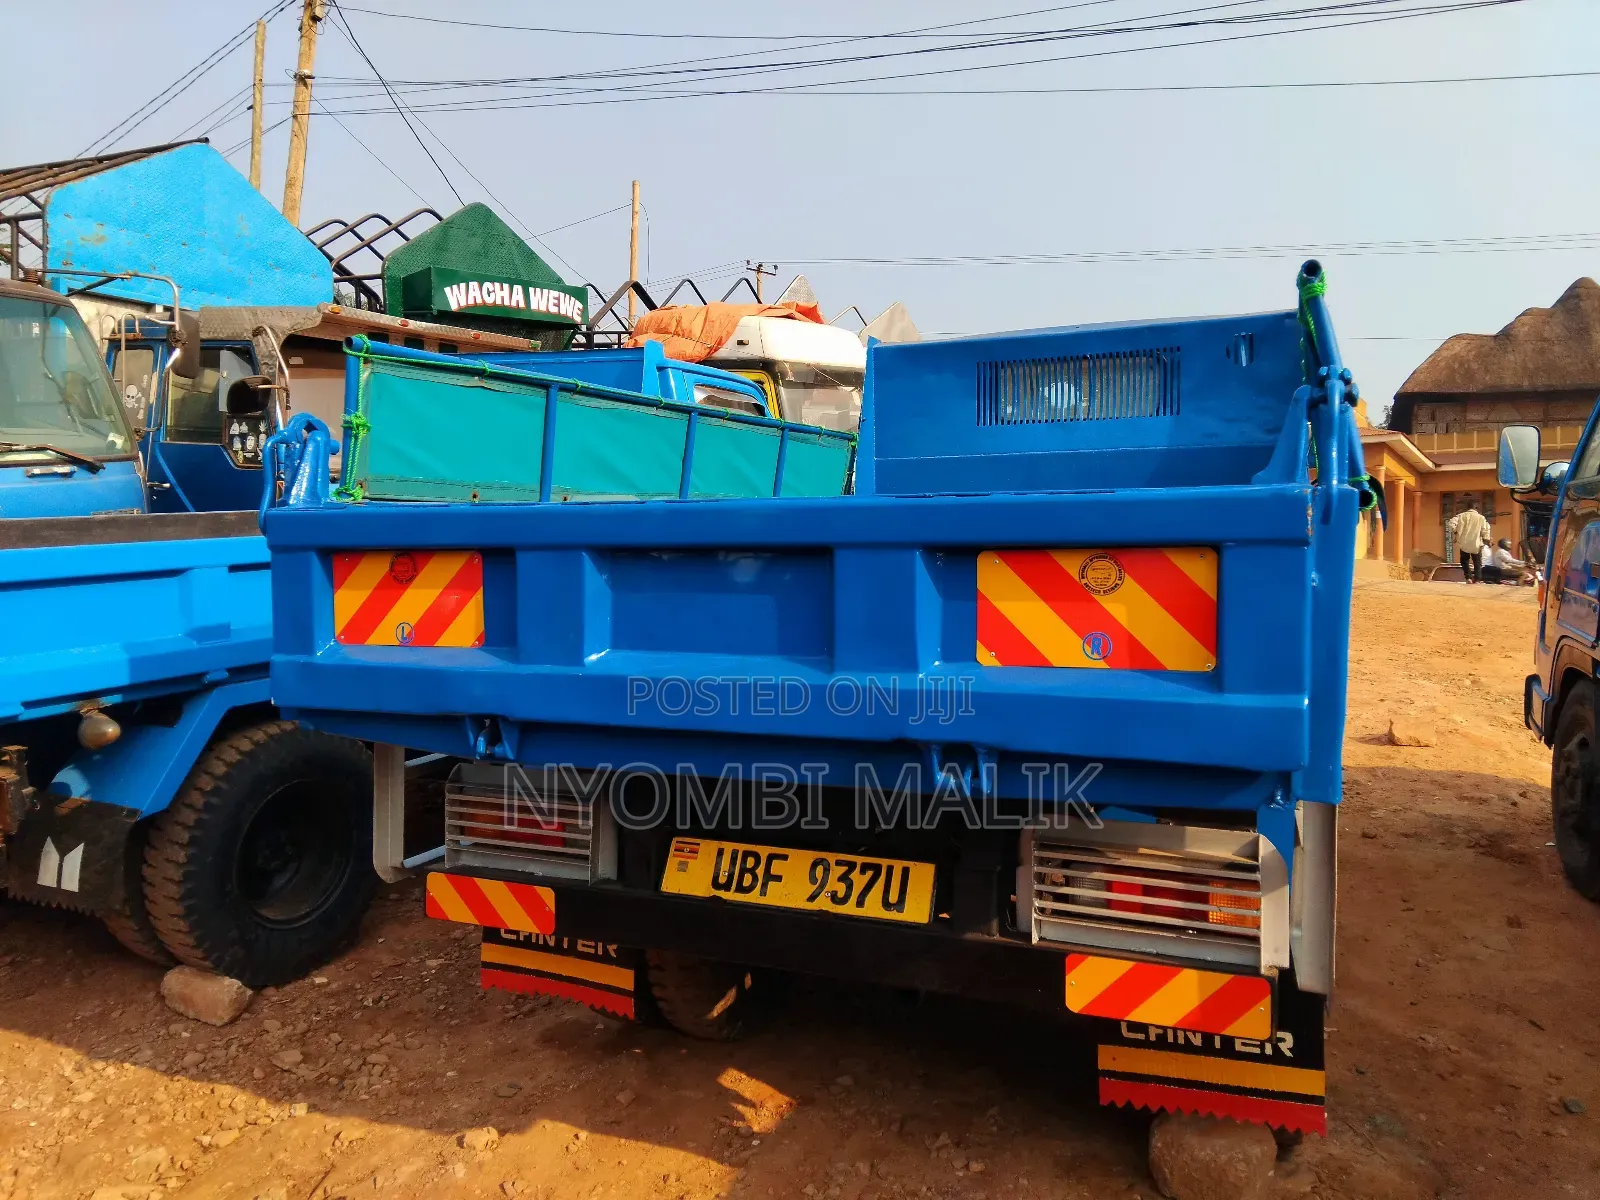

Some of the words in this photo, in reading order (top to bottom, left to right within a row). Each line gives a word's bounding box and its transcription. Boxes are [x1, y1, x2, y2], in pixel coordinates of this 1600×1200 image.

[444, 281, 526, 312] WACHA
[528, 286, 584, 324] WEWE
[711, 847, 790, 897] UBF
[806, 857, 911, 913] 937U
